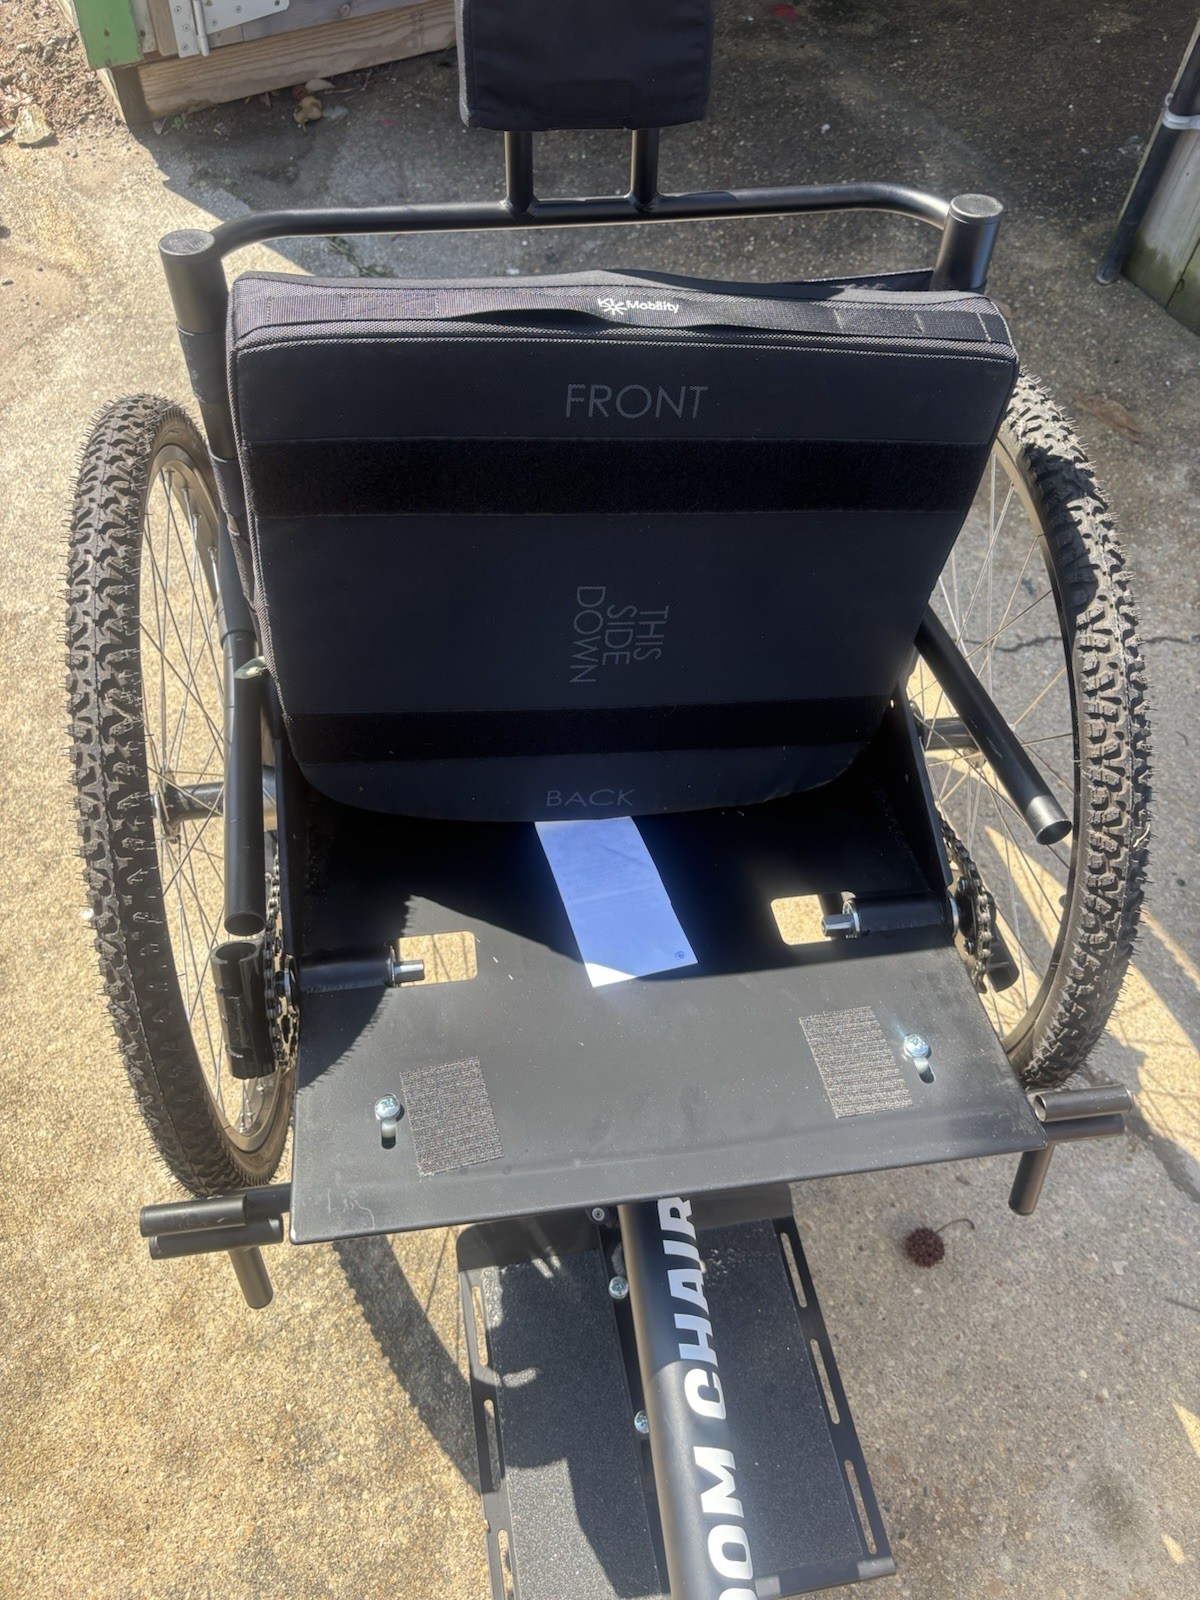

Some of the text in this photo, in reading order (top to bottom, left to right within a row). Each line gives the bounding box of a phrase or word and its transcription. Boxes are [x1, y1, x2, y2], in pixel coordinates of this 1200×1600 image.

[626, 299, 680, 314] Mobility
[565, 383, 709, 419] FRONT
[569, 585, 607, 683] DOWN
[601, 604, 638, 666] SIDE
[633, 605, 670, 660] THIS
[546, 788, 635, 808] BACK
[657, 1196, 758, 1600] OM CHAIR
